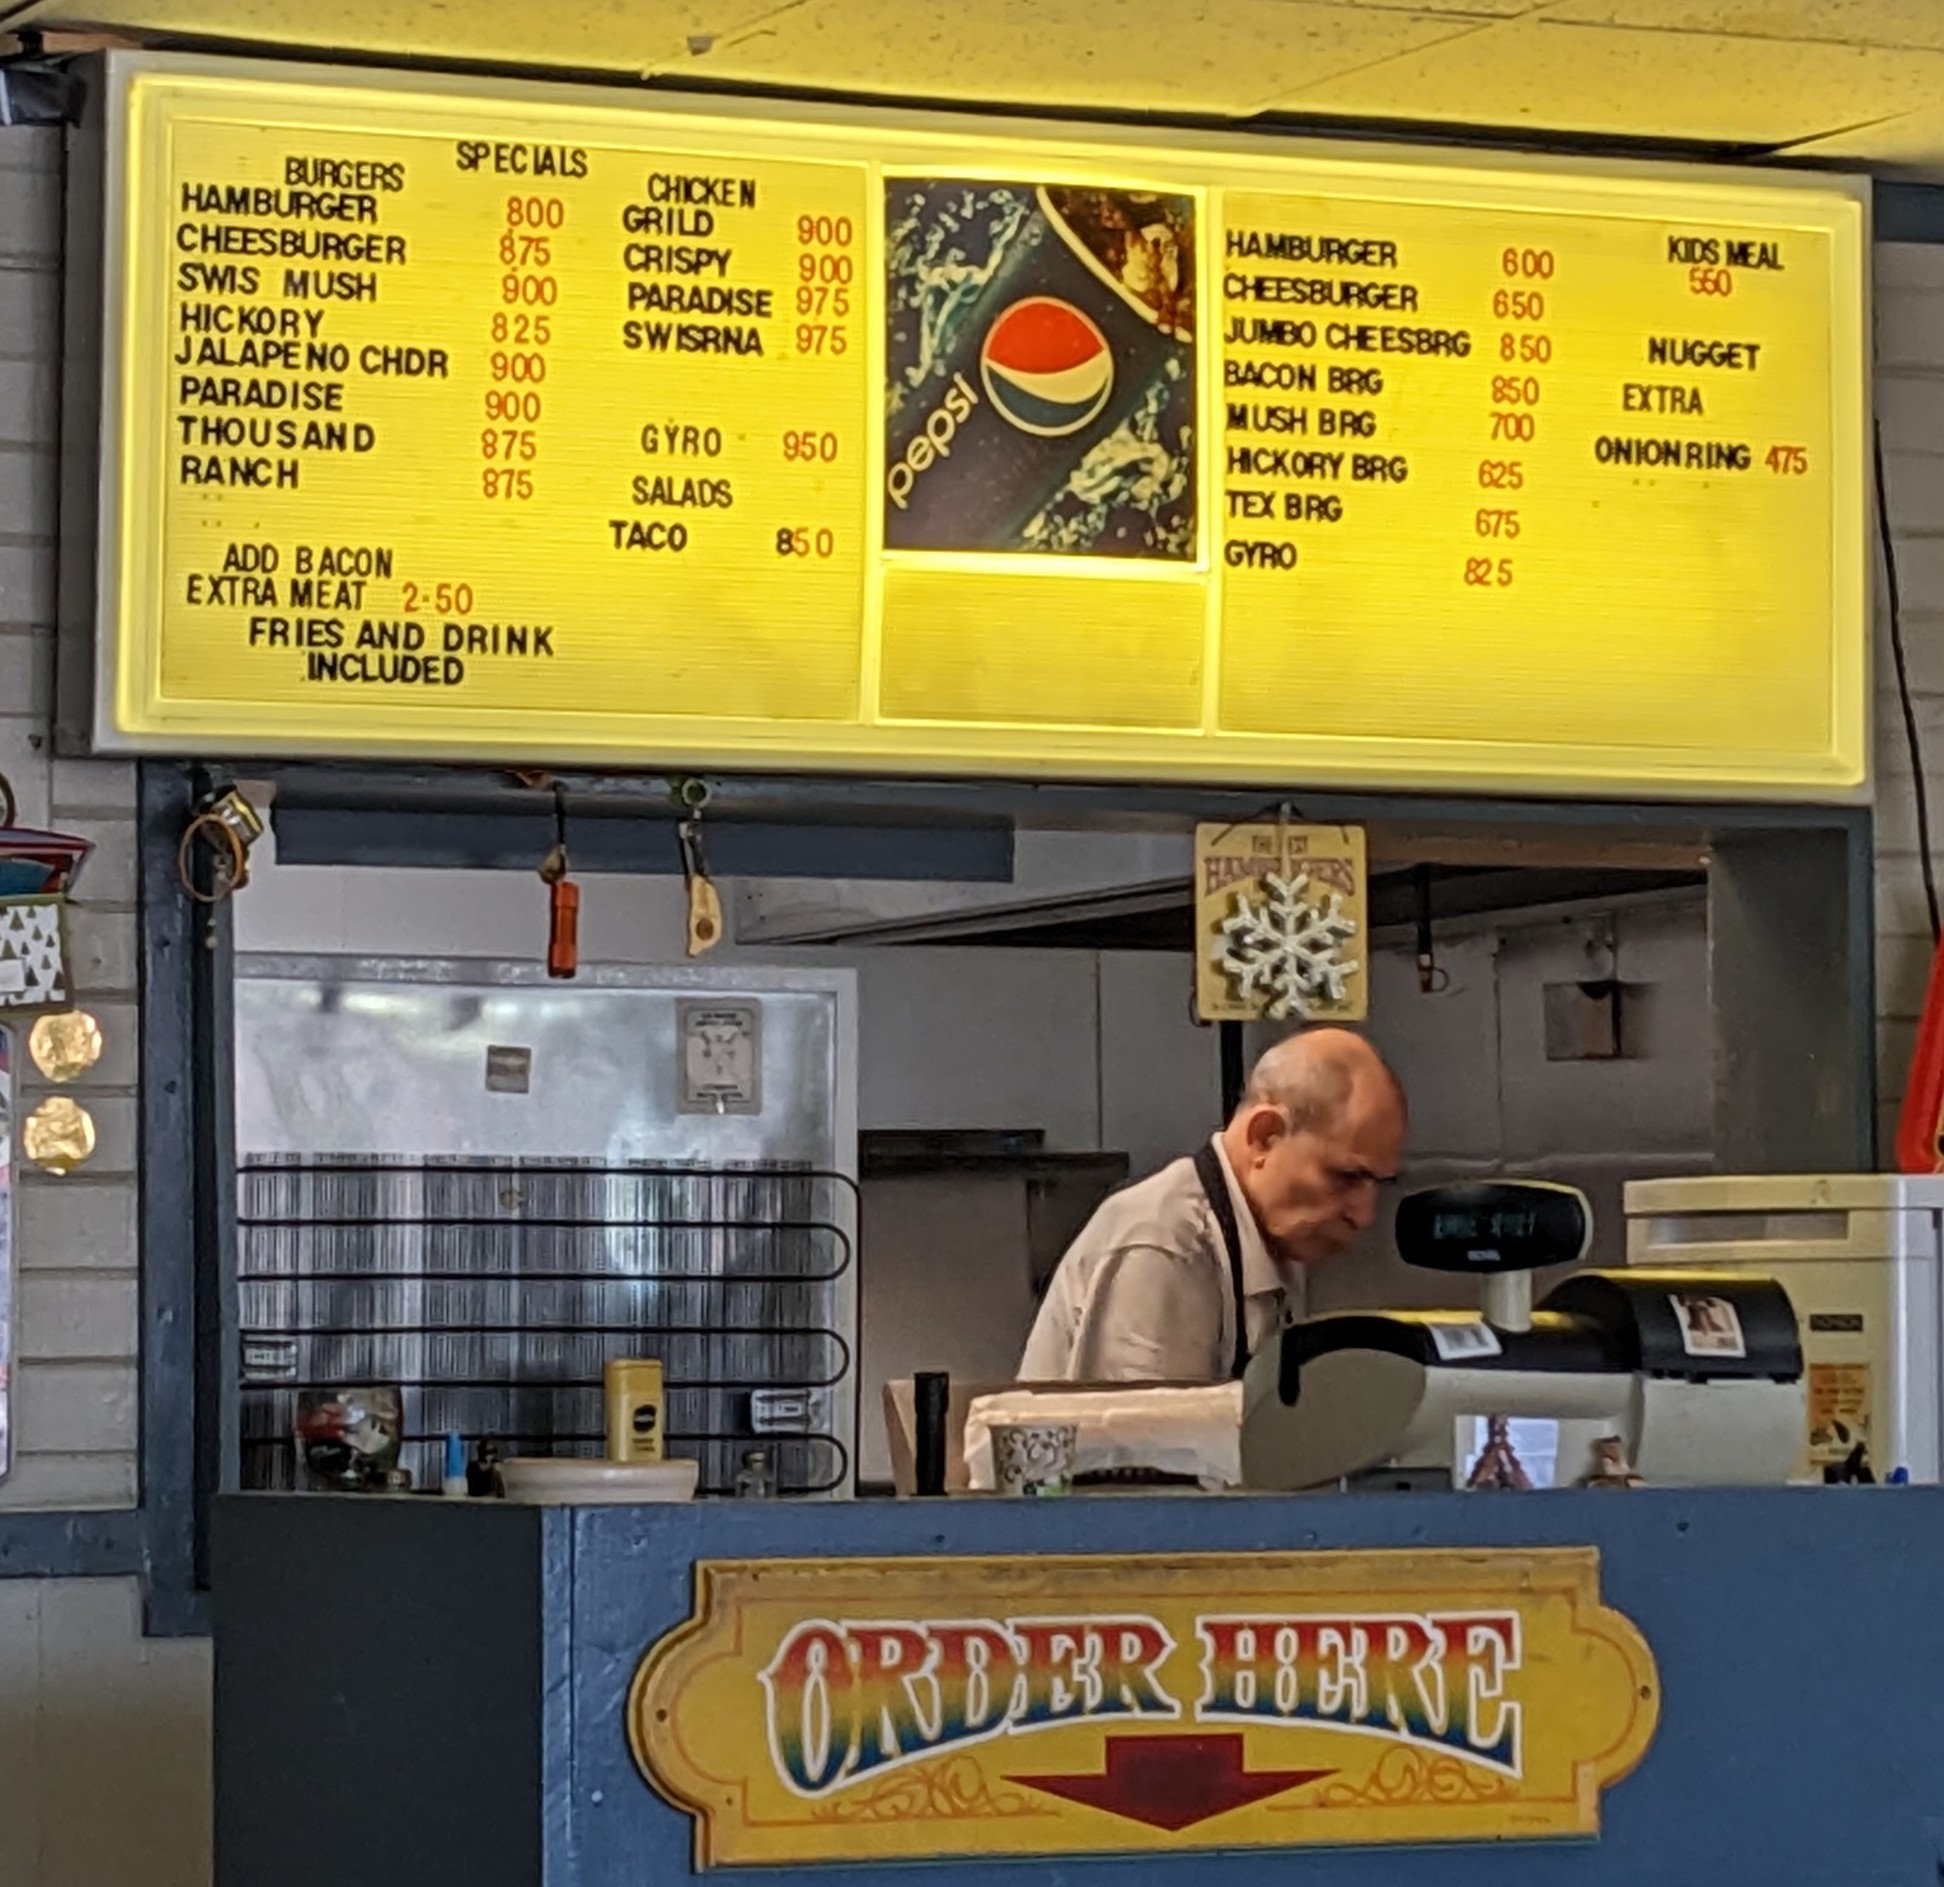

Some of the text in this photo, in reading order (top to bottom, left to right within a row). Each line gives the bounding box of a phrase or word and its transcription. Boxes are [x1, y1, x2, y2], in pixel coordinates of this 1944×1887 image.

[285, 157, 405, 191] BURGERS
[457, 142, 589, 179] SPECIALS
[181, 183, 565, 228] HAMBURGER 800
[646, 172, 756, 208] CHICKEN
[177, 223, 551, 267] CHEESBURGER 875
[622, 204, 852, 247] GRILD 900
[622, 243, 852, 284] CRISPY 900
[1224, 229, 1554, 279] HAMBURGER 600
[1667, 236, 1785, 271] KIDS MEAL
[177, 263, 558, 306] SWIS MUSH 900
[627, 281, 850, 318] PARADISE 975
[1223, 273, 1544, 321] CHEESBURGER 650
[1689, 266, 1733, 297] 550
[179, 301, 552, 346] HICKORY 825
[795, 323, 847, 355] 975
[1223, 317, 1552, 364] JUMBO CHEESBRG 850
[174, 336, 546, 383] JALAPENO CHDR 900
[1647, 336, 1761, 371] NUGGET
[179, 376, 542, 421] PARADISE 900
[1223, 359, 1540, 406] BACON BRG 850
[1621, 383, 1704, 415] EXTRA
[177, 417, 539, 461] THOUSAND 875
[887, 371, 979, 510] pepsi
[1225, 403, 1536, 443] MUSH BRG 700
[641, 425, 838, 463] GYRO 950
[1764, 445, 1809, 476] 475
[179, 456, 536, 500] RANCH 875
[1225, 447, 1523, 490] HICKORY BRG 625
[632, 476, 734, 509] SALADS
[1224, 490, 1521, 539] TEX BRG 675
[609, 520, 835, 559] TACO 850
[223, 542, 393, 579] ADD BACON
[1223, 540, 1513, 589] GYRO 825
[187, 574, 279, 607] EXTRA
[290, 579, 369, 611] MEAT
[249, 617, 555, 657] FRIES AND DRINK
[307, 652, 465, 686] INCLUDED
[759, 1611, 1523, 1797] ORDER HERE
